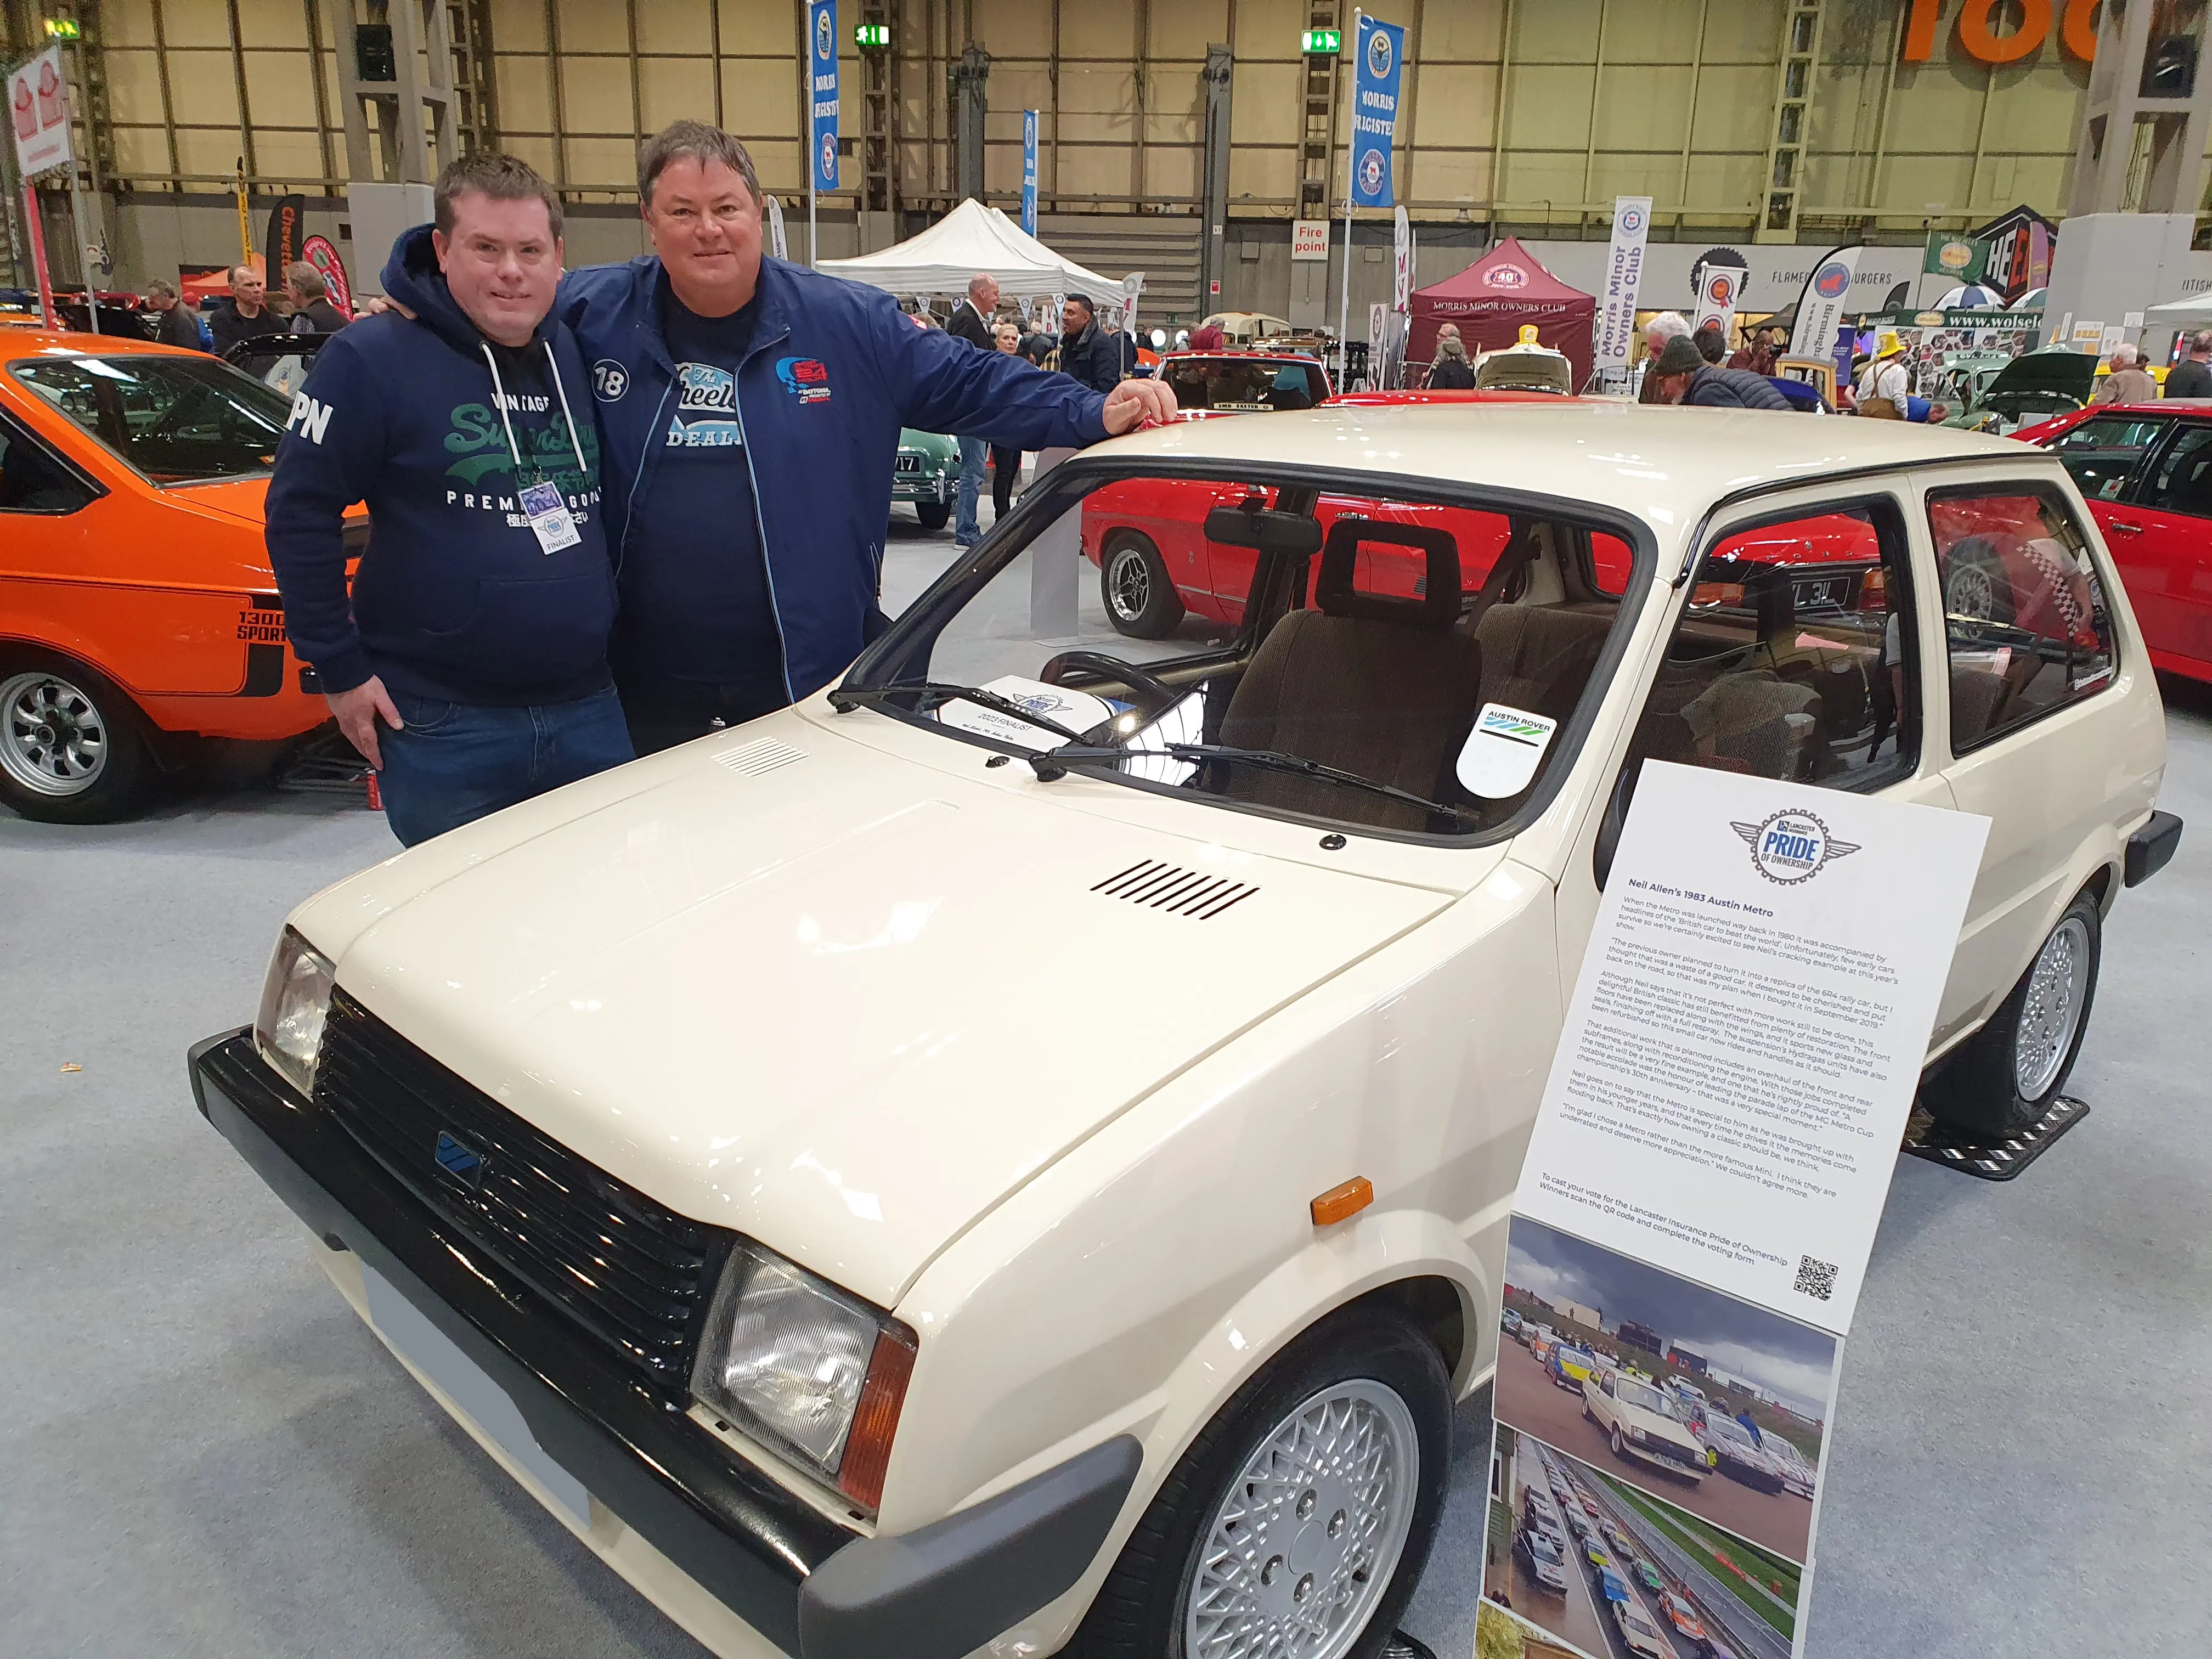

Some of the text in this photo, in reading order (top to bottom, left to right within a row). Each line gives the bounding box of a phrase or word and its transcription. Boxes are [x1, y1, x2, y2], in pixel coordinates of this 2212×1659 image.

[1295, 241, 1326, 254] point
[1299, 226, 1323, 238] Fire
[1497, 273, 1514, 283] 40
[1850, 273, 1893, 285] URGERS
[1433, 301, 1566, 313] MORRIS MINOR OWNERS CLUB
[1601, 245, 1626, 357] Morris Minor
[1613, 246, 1642, 358] Owners Club
[595, 366, 624, 397] 18
[693, 368, 718, 383] The
[283, 390, 334, 445] PN
[665, 430, 742, 447] DEAL
[895, 456, 915, 471] 17
[546, 534, 576, 551] FINALIST
[977, 713, 998, 723] 2023
[997, 717, 1034, 733] FINALIST
[1487, 710, 1551, 732] AUSTIN ROVER
[1760, 853, 1814, 871] OF OWNERSHIP
[1763, 831, 1820, 862] PRIDE
[1628, 878, 1648, 890] Neil
[1684, 890, 1706, 902] 1983
[1706, 896, 1740, 911] Austin
[1742, 903, 1774, 917] Metro
[1621, 904, 1655, 918] headlines
[1663, 915, 1676, 923] the
[1725, 928, 1743, 939] beat
[1743, 933, 1757, 942] the
[1784, 942, 1838, 962] Unfortunately,
[1840, 955, 1855, 965] few
[1857, 961, 1877, 971] early
[1877, 966, 1895, 974] cars
[1624, 896, 1644, 907] When
[1645, 901, 1658, 910] the
[1658, 904, 1680, 915] Metro
[1696, 912, 1731, 927] launched
[1732, 922, 1748, 932] way
[1748, 924, 1767, 935] back
[1768, 929, 1776, 937] in
[1778, 931, 1795, 941] 1980
[1796, 935, 1802, 944] it
[1803, 939, 1819, 947] was
[1819, 943, 1875, 960] accompanied
[1876, 954, 1887, 964] by
[1591, 1003, 1609, 1014] been
[1610, 1009, 1651, 1025] refurbished
[1661, 1023, 1675, 1032] this
[1675, 1028, 1696, 1038] small
[1709, 1037, 1726, 1046] now
[1726, 1041, 1746, 1052] rides
[1746, 1047, 1763, 1057] and
[1763, 1051, 1795, 1065] handles
[1805, 1062, 1812, 1070] it
[1812, 1065, 1842, 1079] should.
[1596, 986, 1873, 1068] floors have been replaced along with the wings, and it sports new glass and
[1587, 1019, 1602, 1030] That
[1602, 1025, 1639, 1040] additional
[1639, 1035, 1657, 1046] work
[1658, 1040, 1674, 1051] that
[1674, 1044, 1681, 1052] is
[1681, 1048, 1713, 1062] planned
[1713, 1056, 1745, 1071] includes
[1757, 1070, 1791, 1084] overhaul
[1802, 1081, 1816, 1091] the
[1816, 1085, 1838, 1098] front
[1838, 1093, 1855, 1102] and
[1856, 1098, 1873, 1107] rear
[1540, 1181, 1754, 1265] Winners scan the QR code and complete the voting form
[1542, 1172, 1550, 1181] To
[1551, 1177, 1567, 1187] cast
[1566, 1182, 1585, 1194] your
[1585, 1189, 1602, 1200] vote
[1602, 1194, 1615, 1204] for
[1615, 1199, 1628, 1209] the
[1629, 1204, 1668, 1223] Lancaster
[1668, 1217, 1708, 1238] Insurance
[1709, 1232, 1731, 1246] Pride
[1742, 1244, 1788, 1267] Ownership
